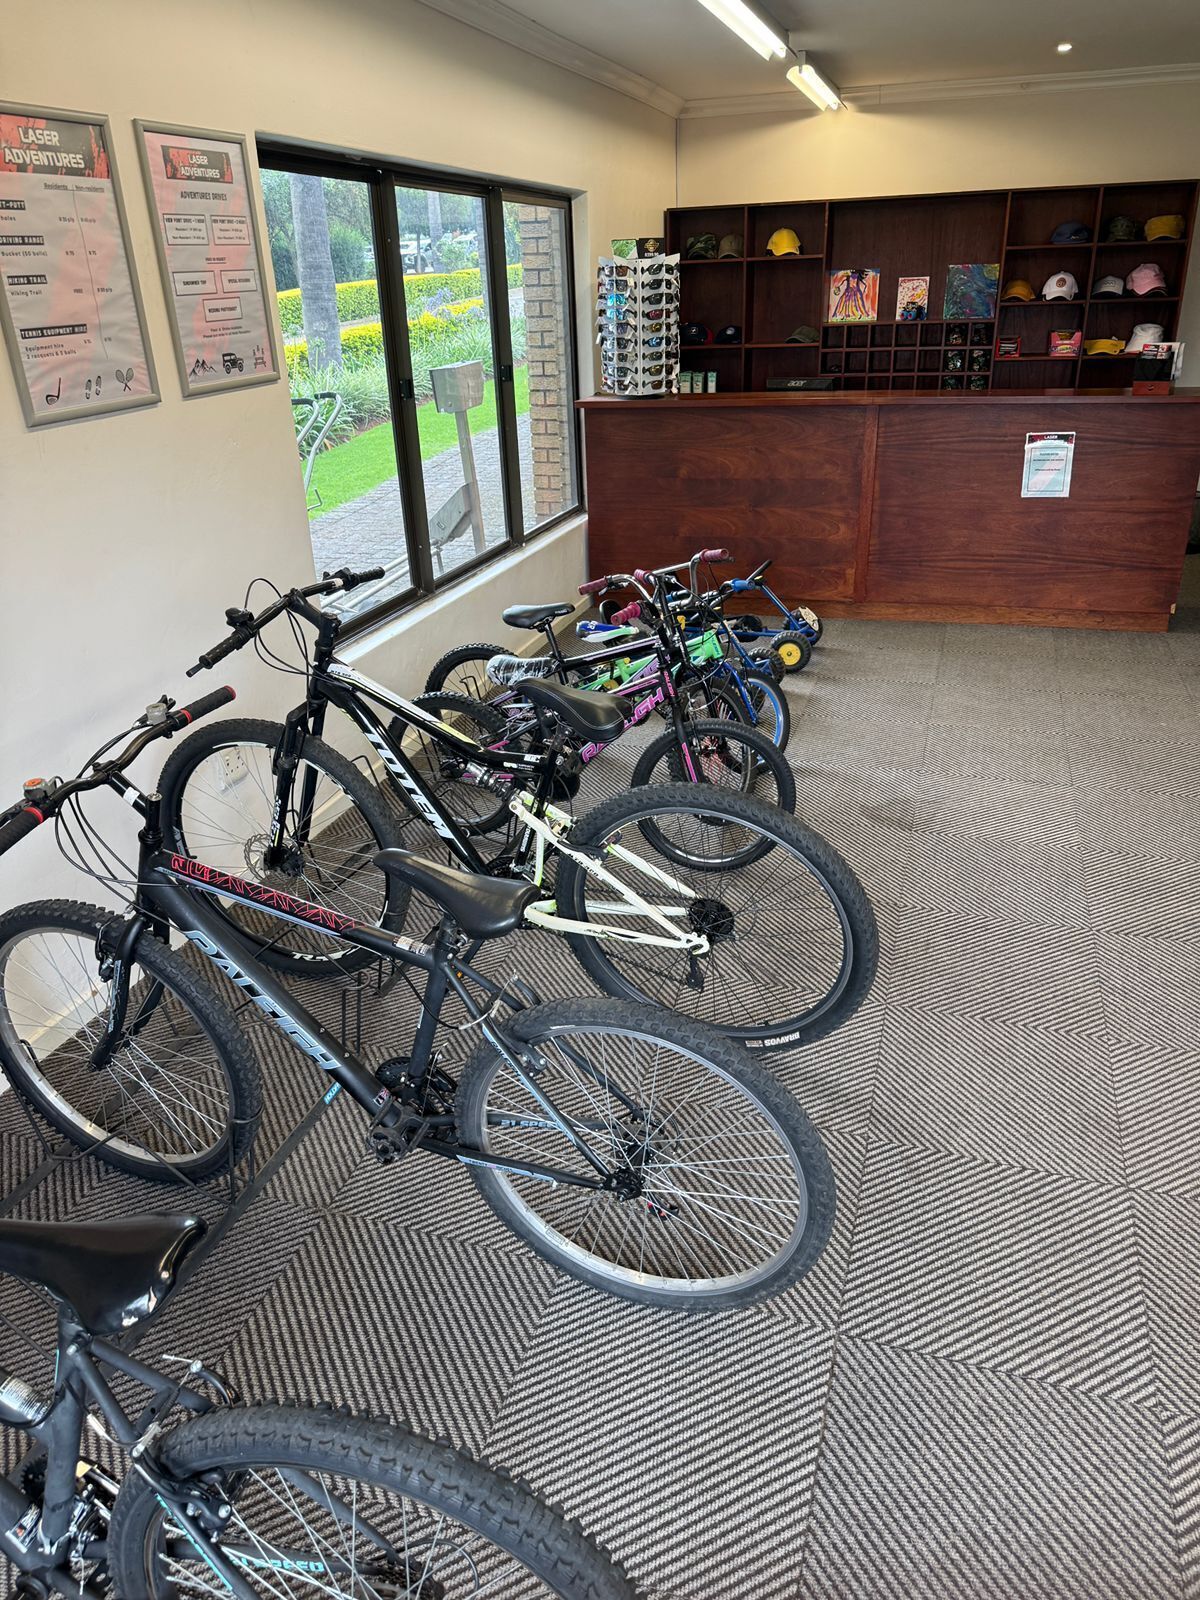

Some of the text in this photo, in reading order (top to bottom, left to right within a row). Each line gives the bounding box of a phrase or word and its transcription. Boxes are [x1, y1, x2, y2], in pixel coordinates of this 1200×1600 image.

[18, 126, 60, 146] LASER
[4, 148, 85, 168] ADVENTURES
[188, 154, 208, 165] LASER
[181, 166, 220, 178] ADVENTURES
[44, 182, 68, 190] Residents
[180, 191, 227, 201] ADVENTURES DRIVES
[24, 236, 43, 244] RANGE
[8, 275, 48, 285] HIKING TRAIL
[21, 325, 87, 339] TENNIS EQUIPMENT HIRE
[183, 929, 342, 1070] RALEIGH
